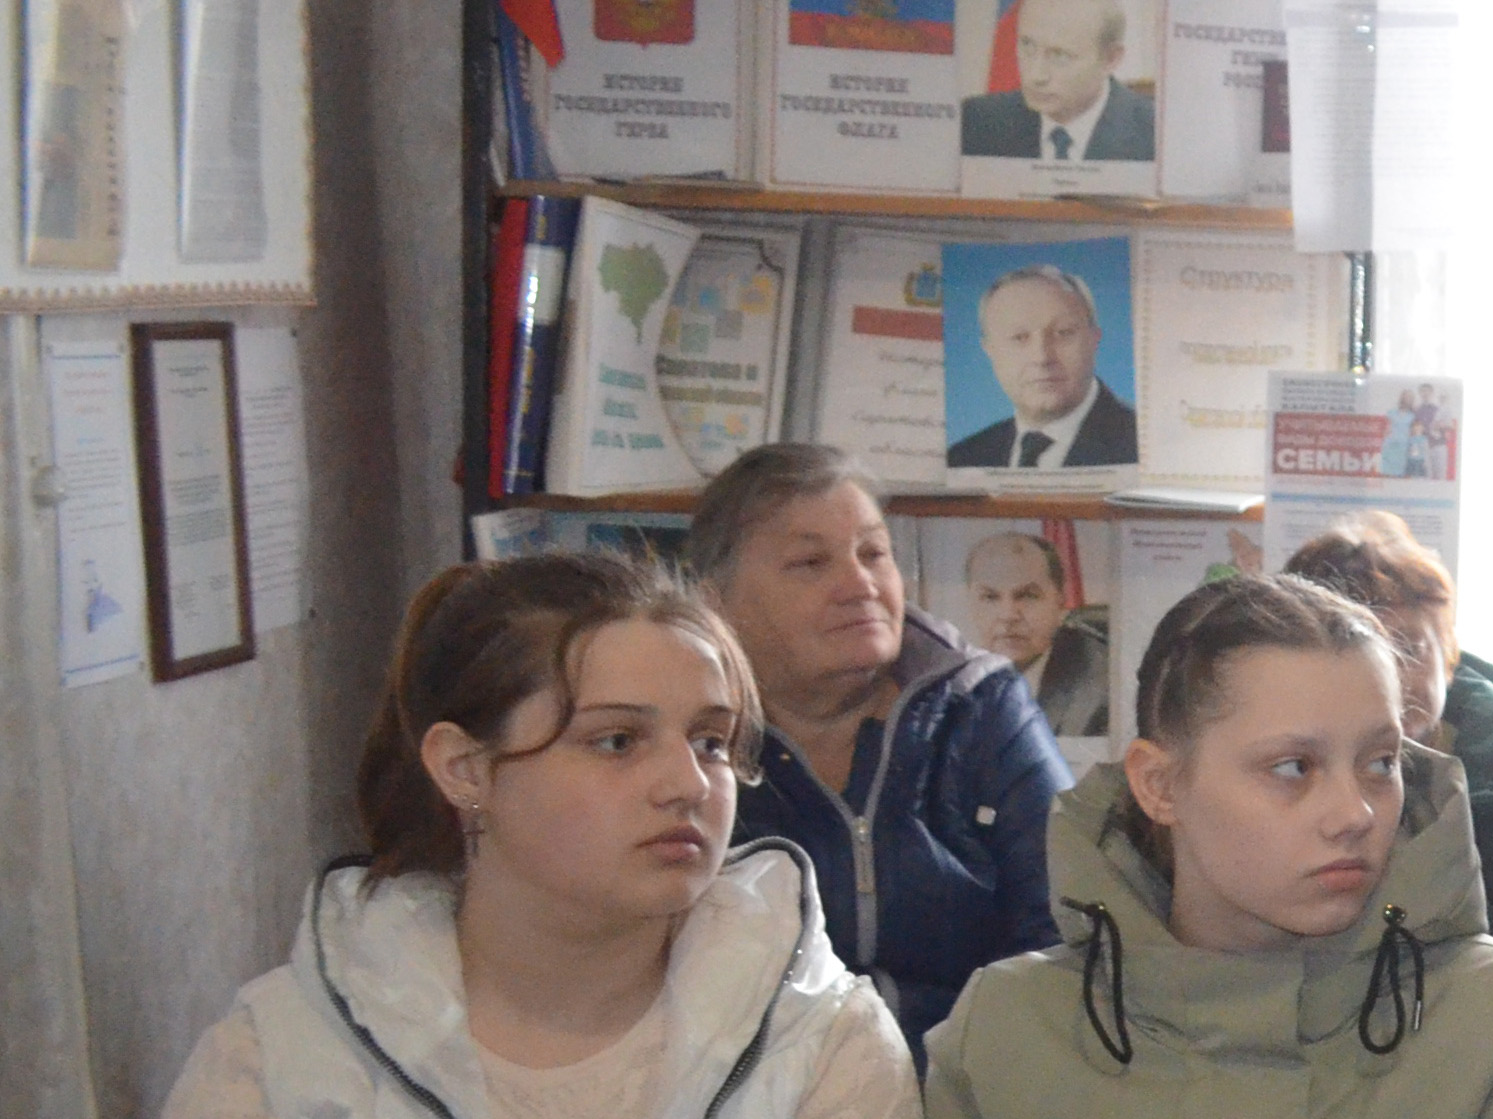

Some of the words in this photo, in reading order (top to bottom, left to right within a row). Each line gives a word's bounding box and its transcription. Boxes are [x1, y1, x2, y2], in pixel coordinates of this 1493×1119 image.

[603, 73, 684, 93] ИСТОРИЯ
[829, 73, 909, 93] ИСТОРИЯ
[1276, 447, 1382, 473] СЕМЬИ
